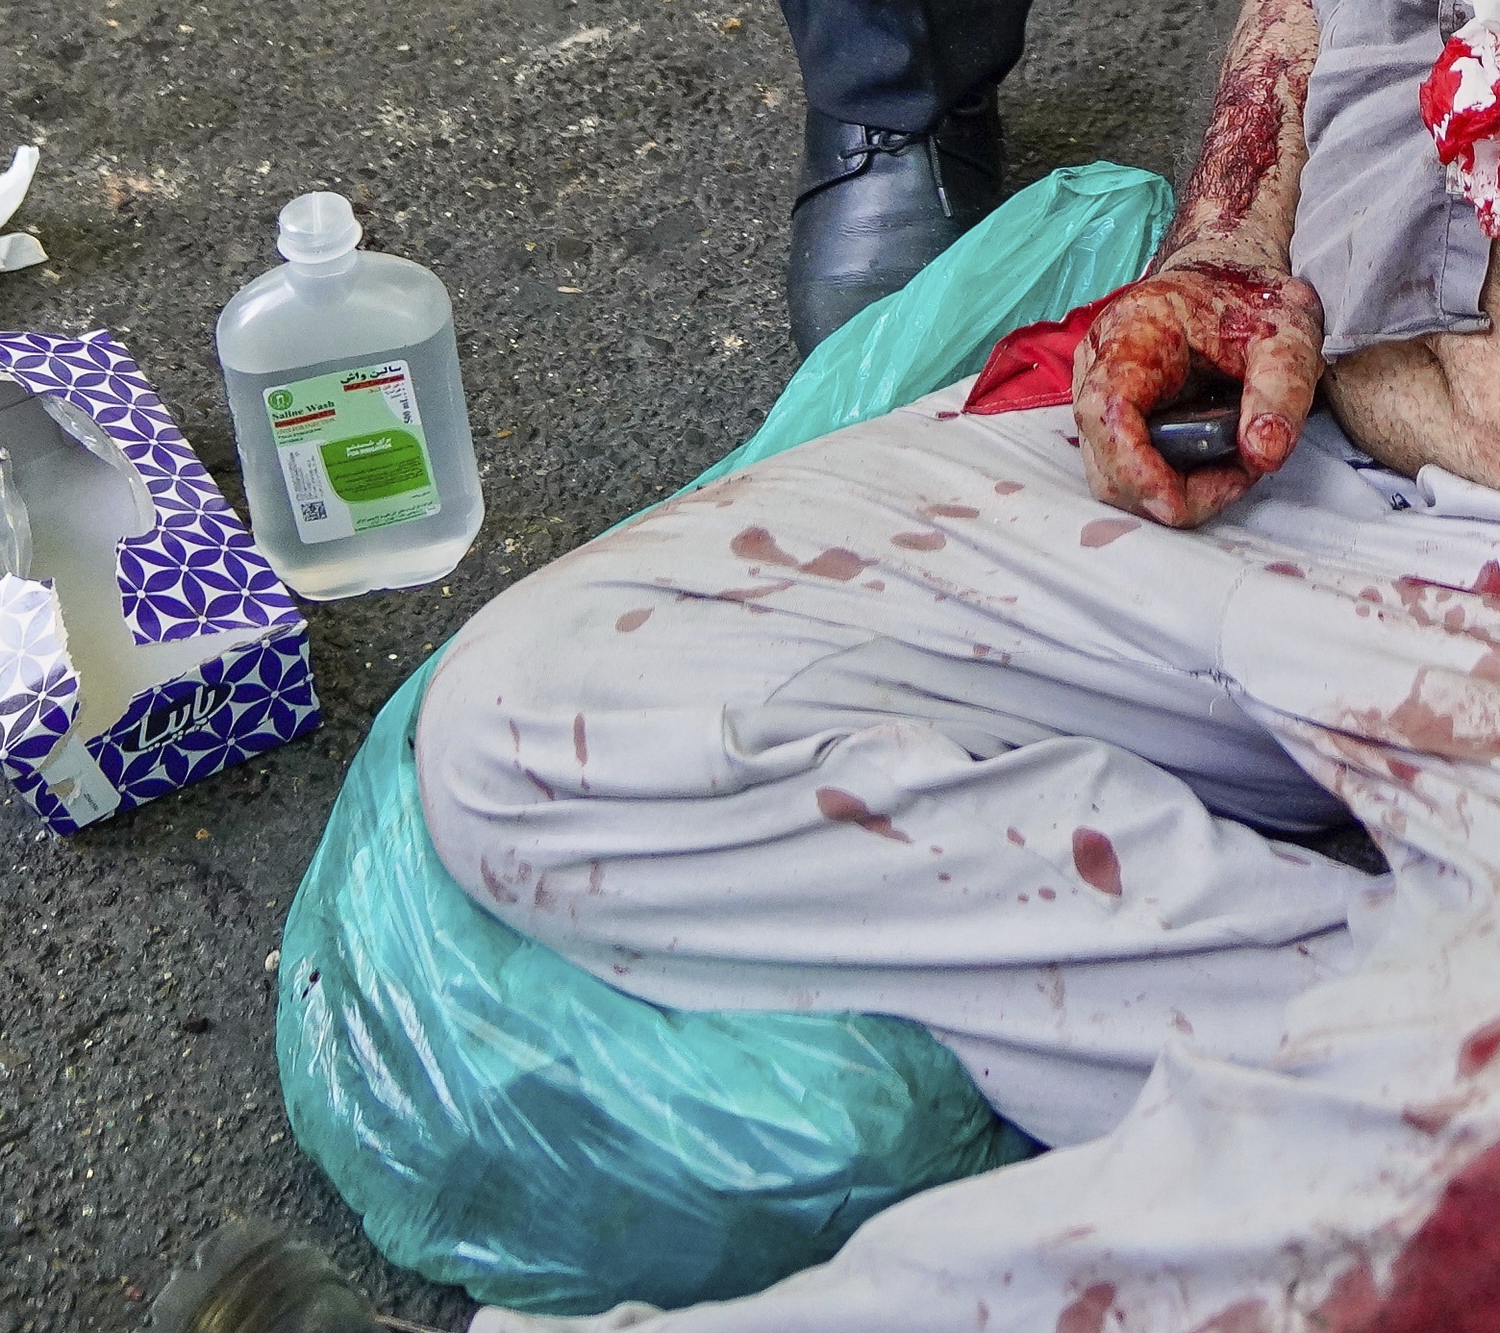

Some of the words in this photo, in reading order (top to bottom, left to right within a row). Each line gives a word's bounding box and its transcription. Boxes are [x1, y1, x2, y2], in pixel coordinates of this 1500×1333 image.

[340, 372, 367, 384] واش
[271, 410, 304, 421] Saline
[305, 400, 335, 412] Wash
